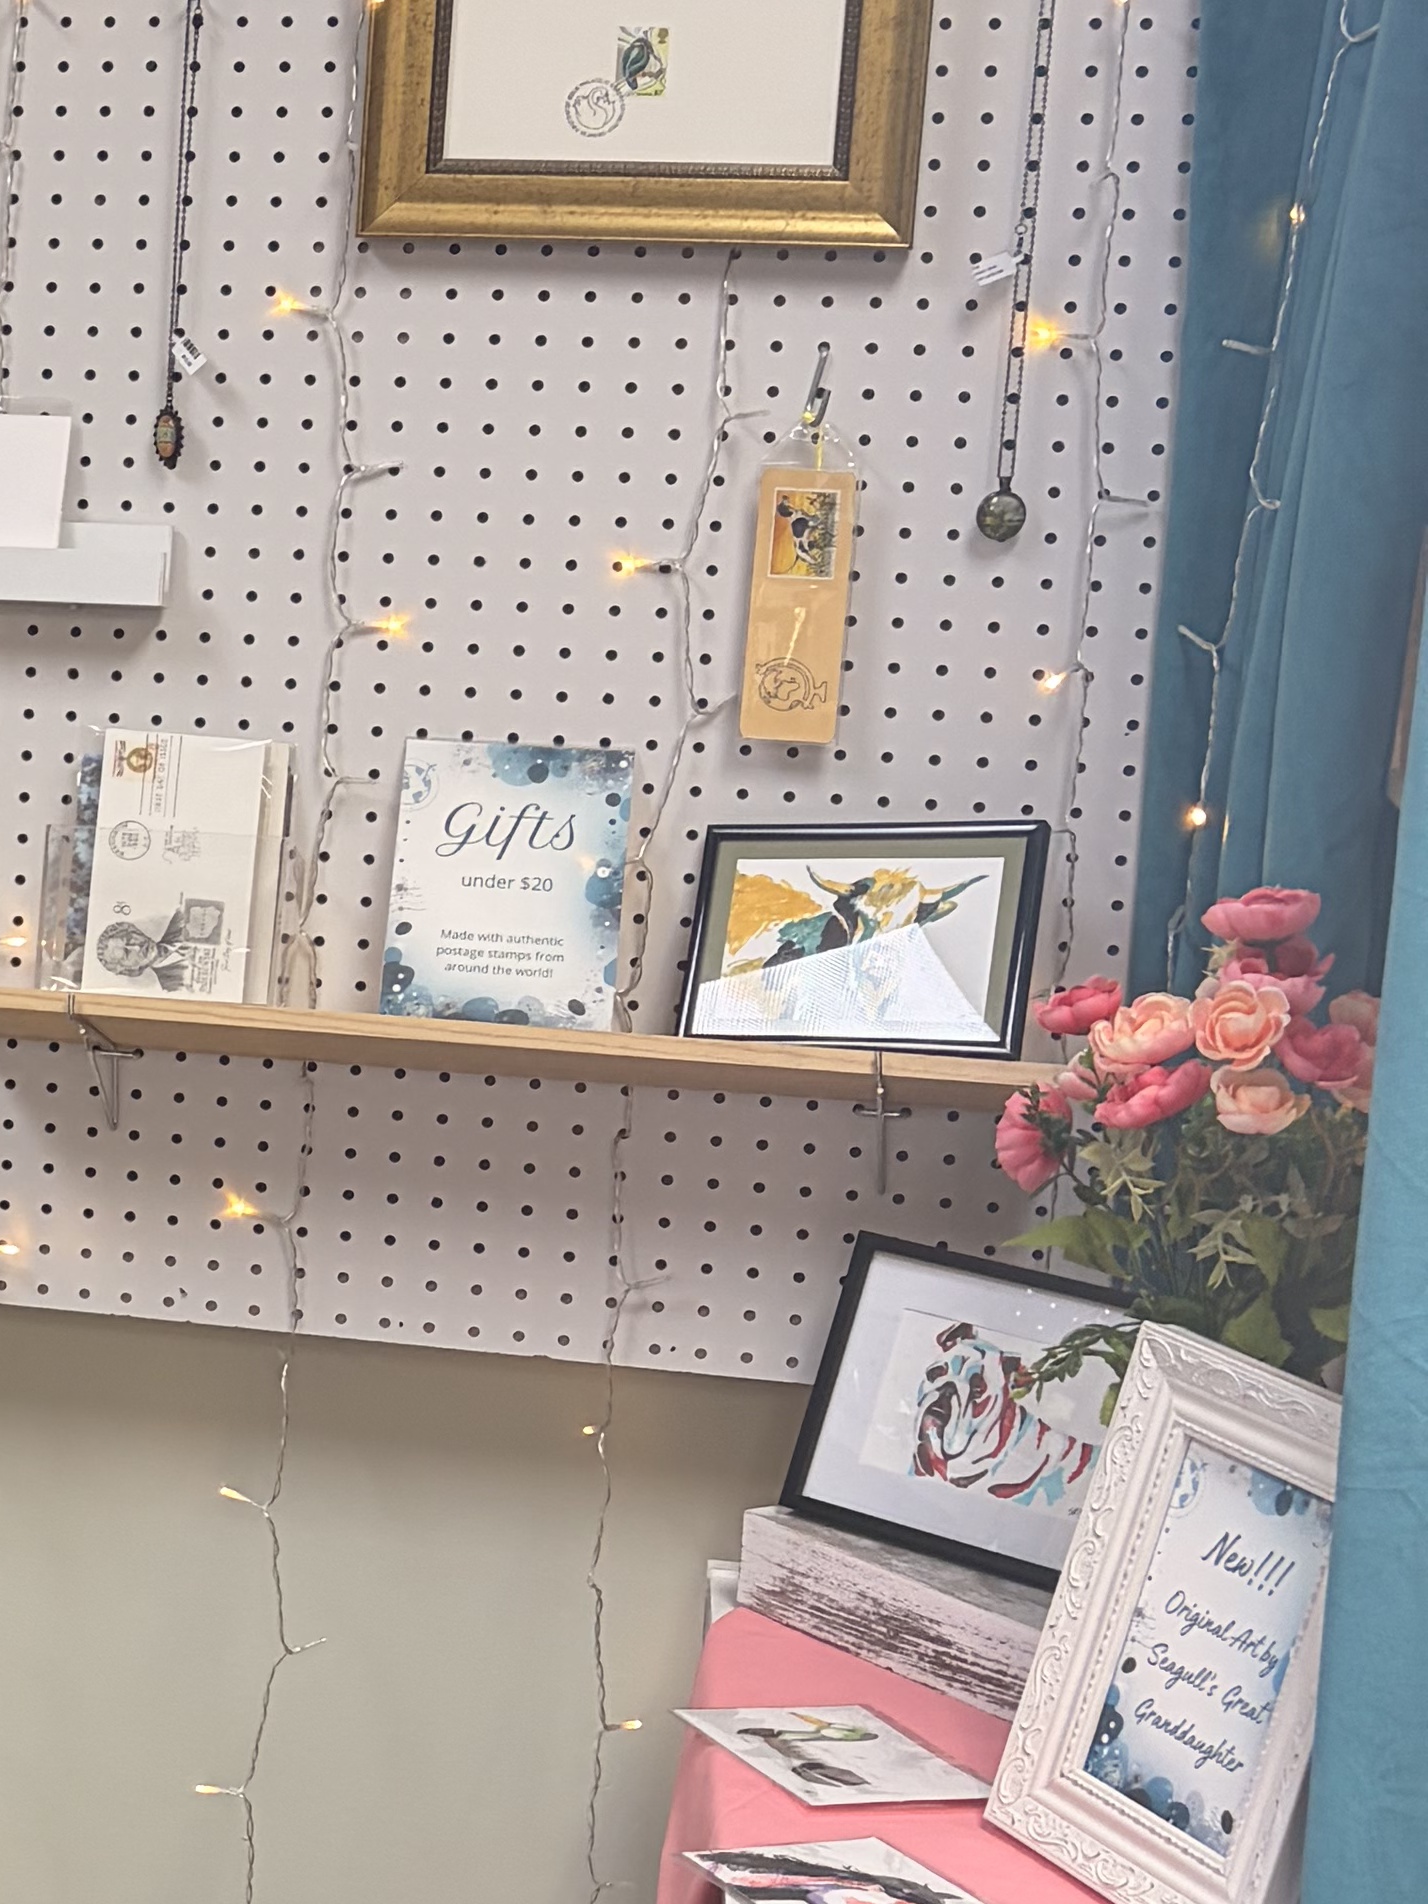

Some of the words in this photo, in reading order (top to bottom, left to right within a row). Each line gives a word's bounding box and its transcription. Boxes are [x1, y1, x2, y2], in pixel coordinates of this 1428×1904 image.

[435, 802, 576, 860] Gifts
[461, 873, 516, 890] under
[520, 875, 554, 893] $20
[436, 946, 484, 960] postage
[487, 949, 532, 962] stamps
[535, 950, 565, 963] from
[440, 928, 473, 943] Made
[477, 932, 504, 944] with
[506, 932, 565, 946] authentic
[444, 963, 489, 975] around
[492, 965, 512, 976] the
[515, 966, 554, 978] world!
[1201, 1531, 1295, 1597] New!!!
[1164, 1590, 1236, 1645] Original
[1230, 1628, 1263, 1659] Art
[1260, 1638, 1279, 1678] by
[1147, 1643, 1219, 1698] Seagull's
[1221, 1686, 1273, 1725] Great
[1133, 1698, 1245, 1774] Granddaughter
